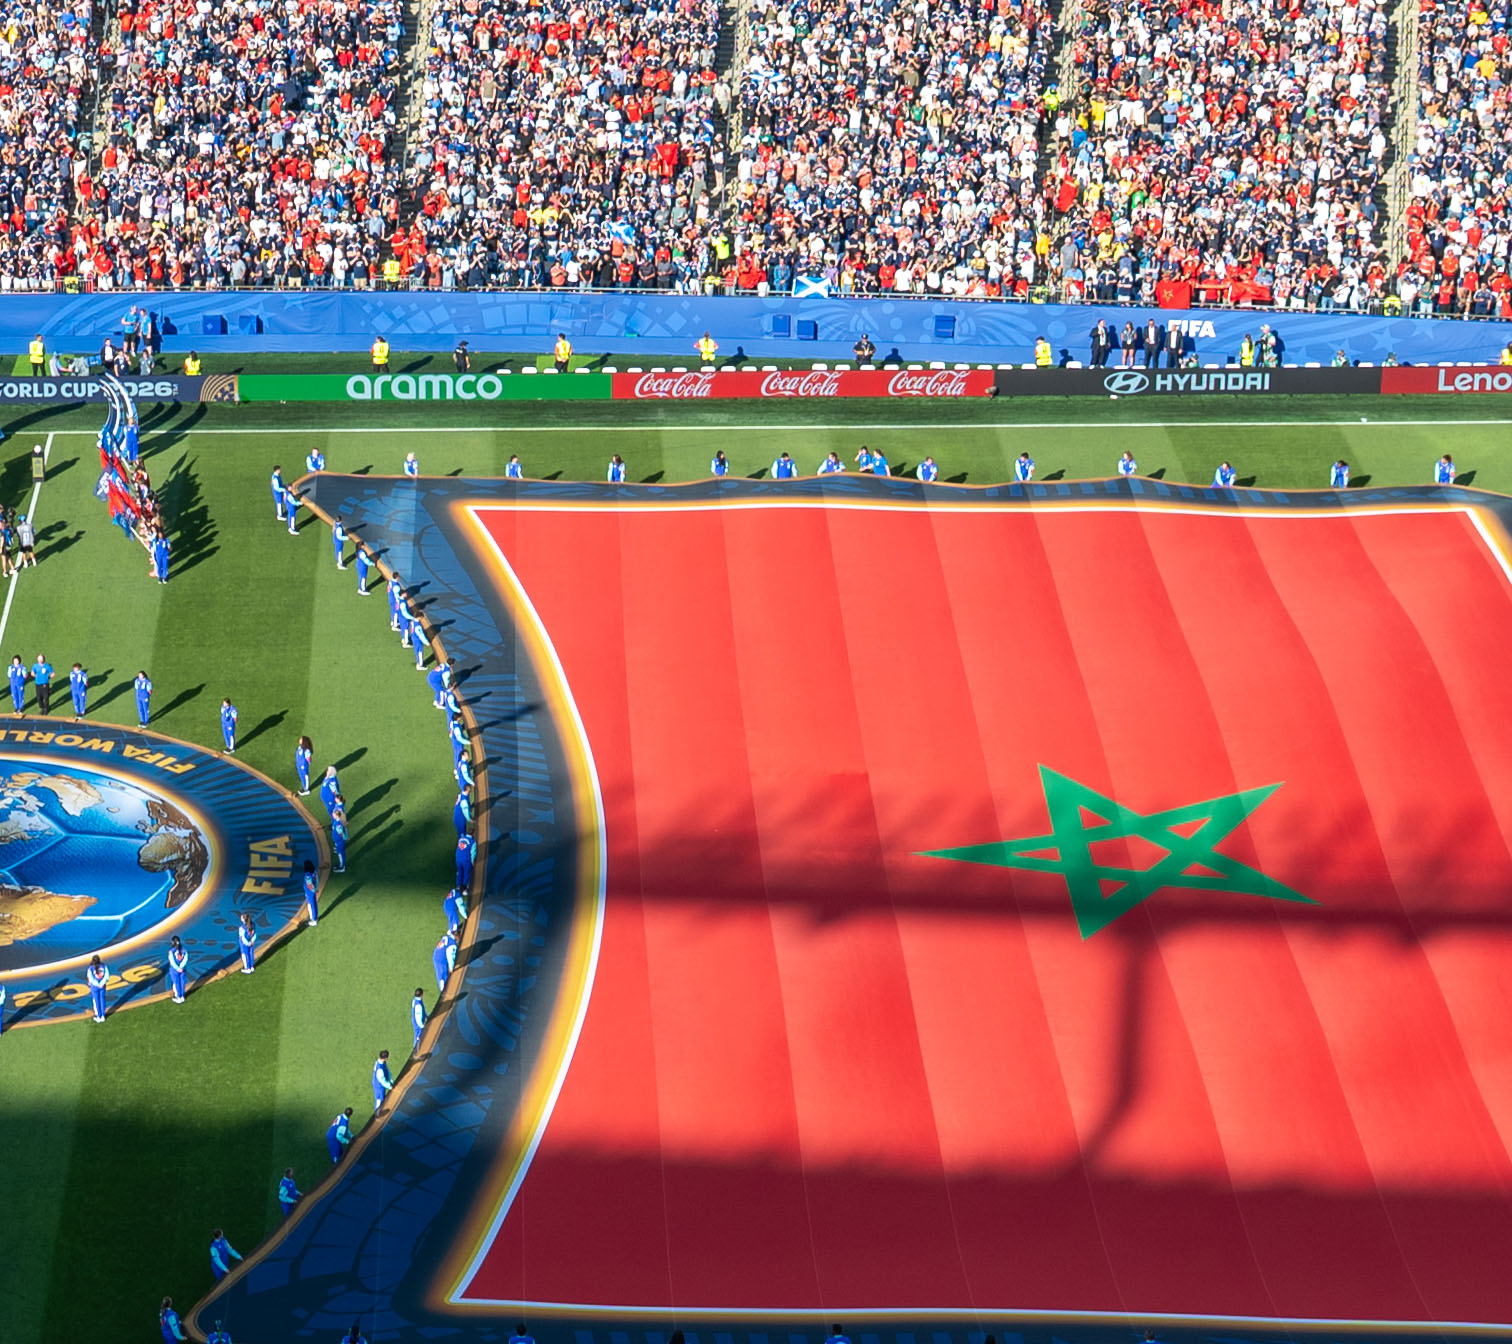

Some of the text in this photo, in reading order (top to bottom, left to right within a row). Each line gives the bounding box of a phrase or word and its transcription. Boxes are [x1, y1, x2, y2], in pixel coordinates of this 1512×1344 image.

[1167, 319, 1216, 338] FIFA
[60, 382, 101, 398] CUP
[346, 374, 503, 400] aramco
[1155, 373, 1270, 391] HYUNDAI
[122, 742, 197, 774] FIFA
[240, 835, 292, 896] FIFA
